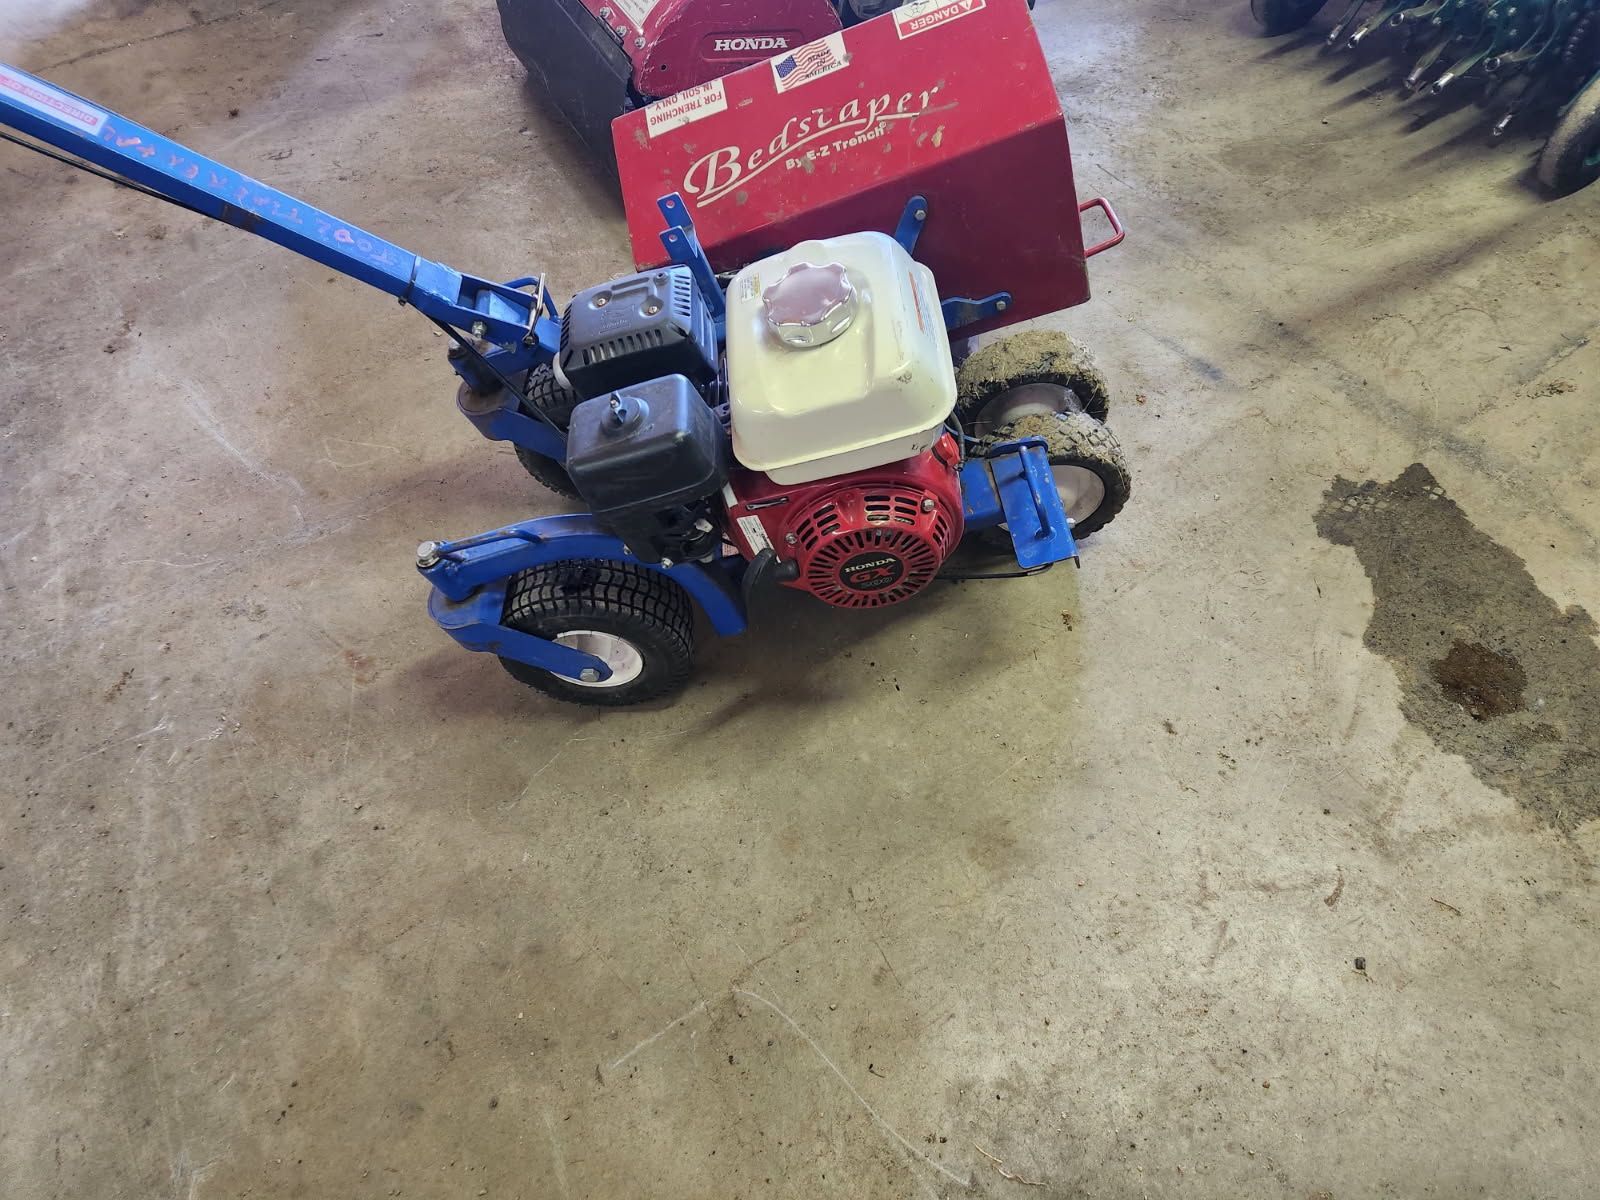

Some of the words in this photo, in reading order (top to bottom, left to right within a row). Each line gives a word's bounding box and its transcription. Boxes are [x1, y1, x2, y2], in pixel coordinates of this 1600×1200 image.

[910, 5, 960, 31] DANGER
[714, 37, 788, 51] HONDA
[807, 48, 831, 63] MADE
[804, 60, 842, 80] AMERICA
[703, 82, 713, 92] IN
[655, 94, 678, 111] ONLY
[703, 91, 722, 105] FOR
[650, 99, 702, 126] TRENCHING
[785, 158, 802, 170] By
[806, 145, 831, 161] E-Z
[832, 127, 885, 152] Trench
[844, 557, 897, 573] HONDA
[850, 564, 896, 584] GX
